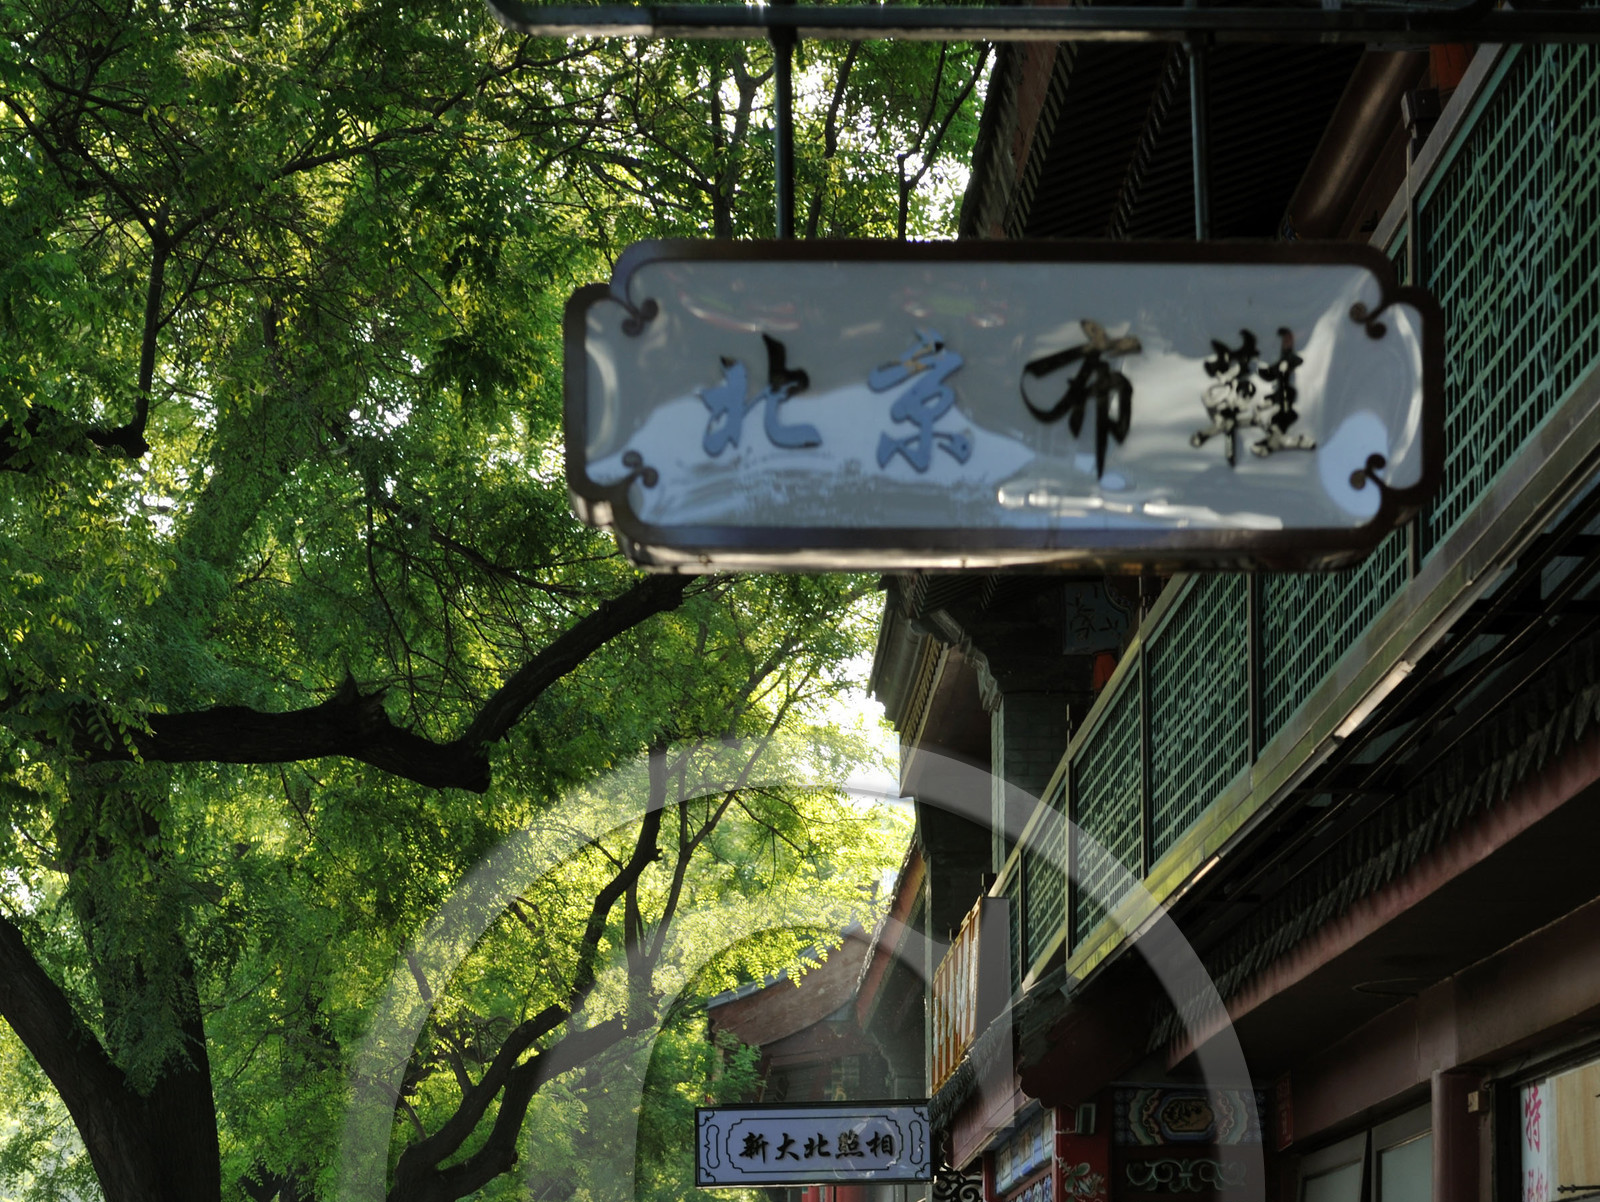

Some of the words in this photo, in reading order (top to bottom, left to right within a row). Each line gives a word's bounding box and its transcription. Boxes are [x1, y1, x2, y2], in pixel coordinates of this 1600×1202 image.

[693, 318, 1317, 480] 北京布鞋
[738, 1129, 896, 1164] 新大北照相
